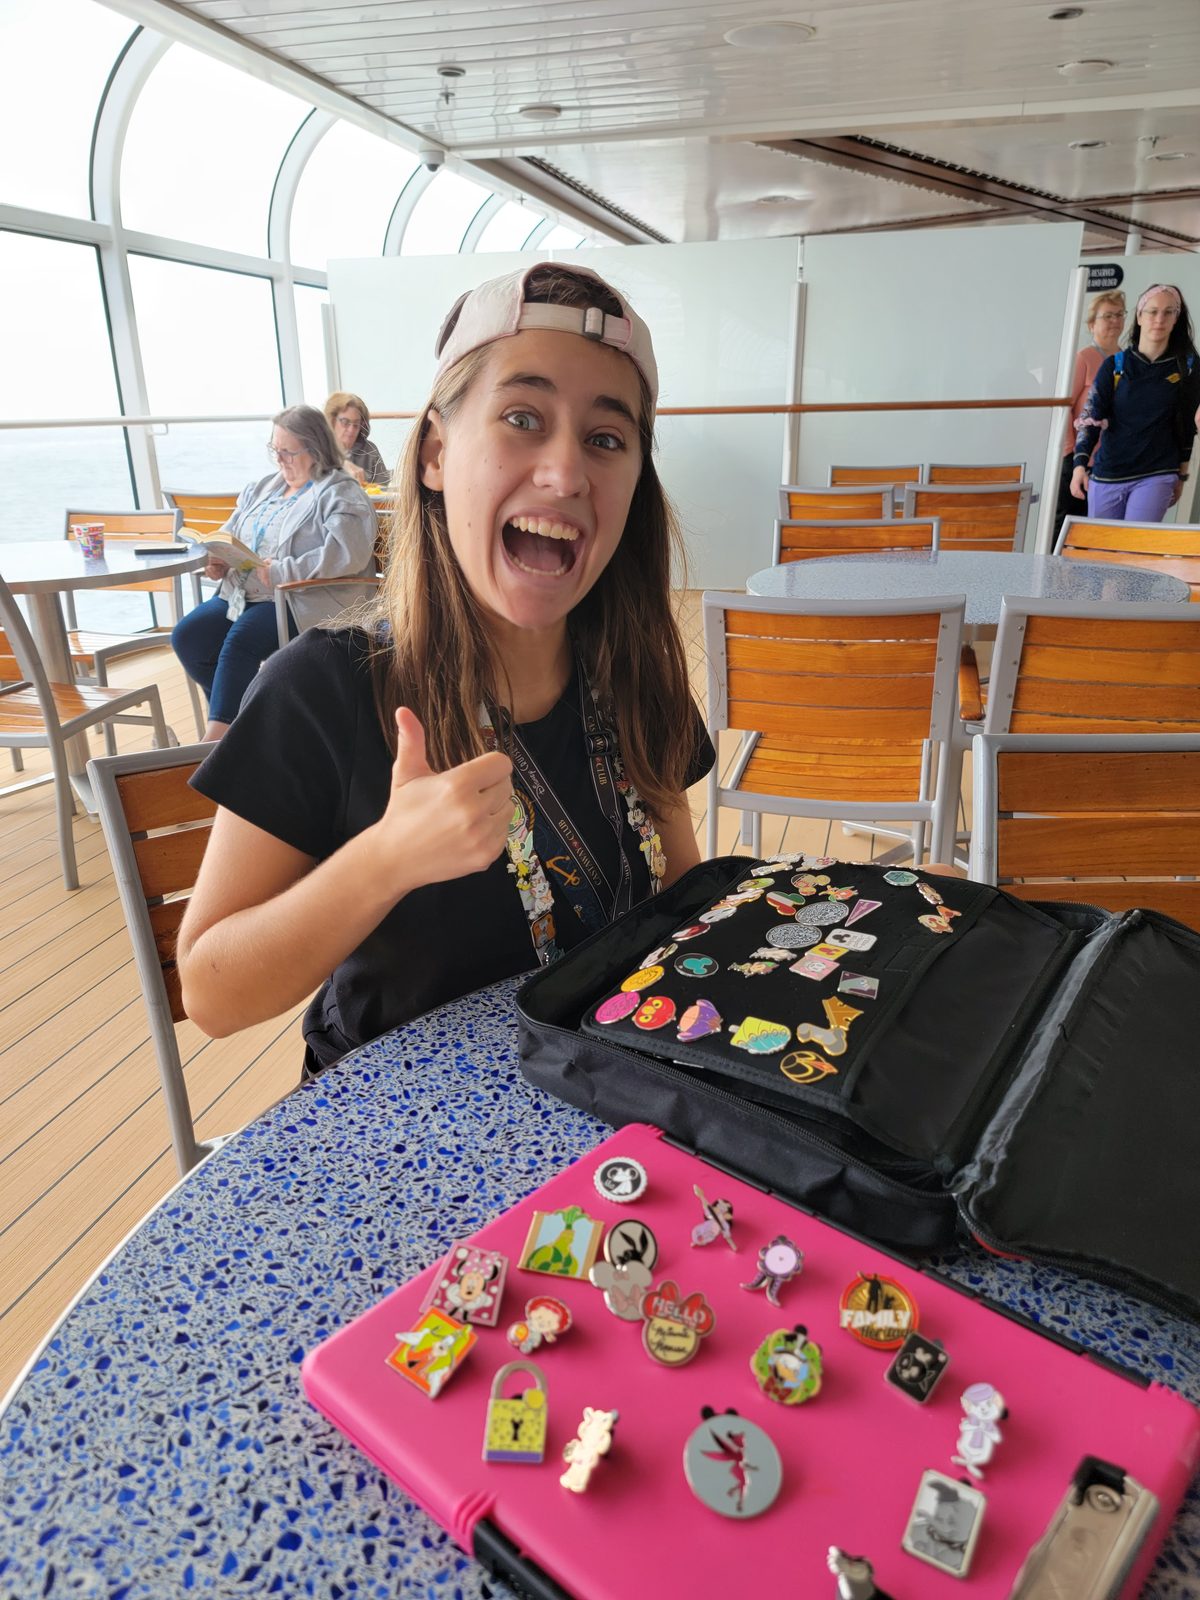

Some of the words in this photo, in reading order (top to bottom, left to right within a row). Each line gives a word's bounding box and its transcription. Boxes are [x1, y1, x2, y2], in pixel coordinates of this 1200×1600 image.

[1091, 268, 1115, 277] RESERVED
[595, 763, 608, 786] CLUB
[558, 819, 575, 843] CLUB
[576, 846, 602, 887] CASTAWAY
[652, 1296, 706, 1324] HELLO
[840, 1308, 912, 1329] FAMILY
